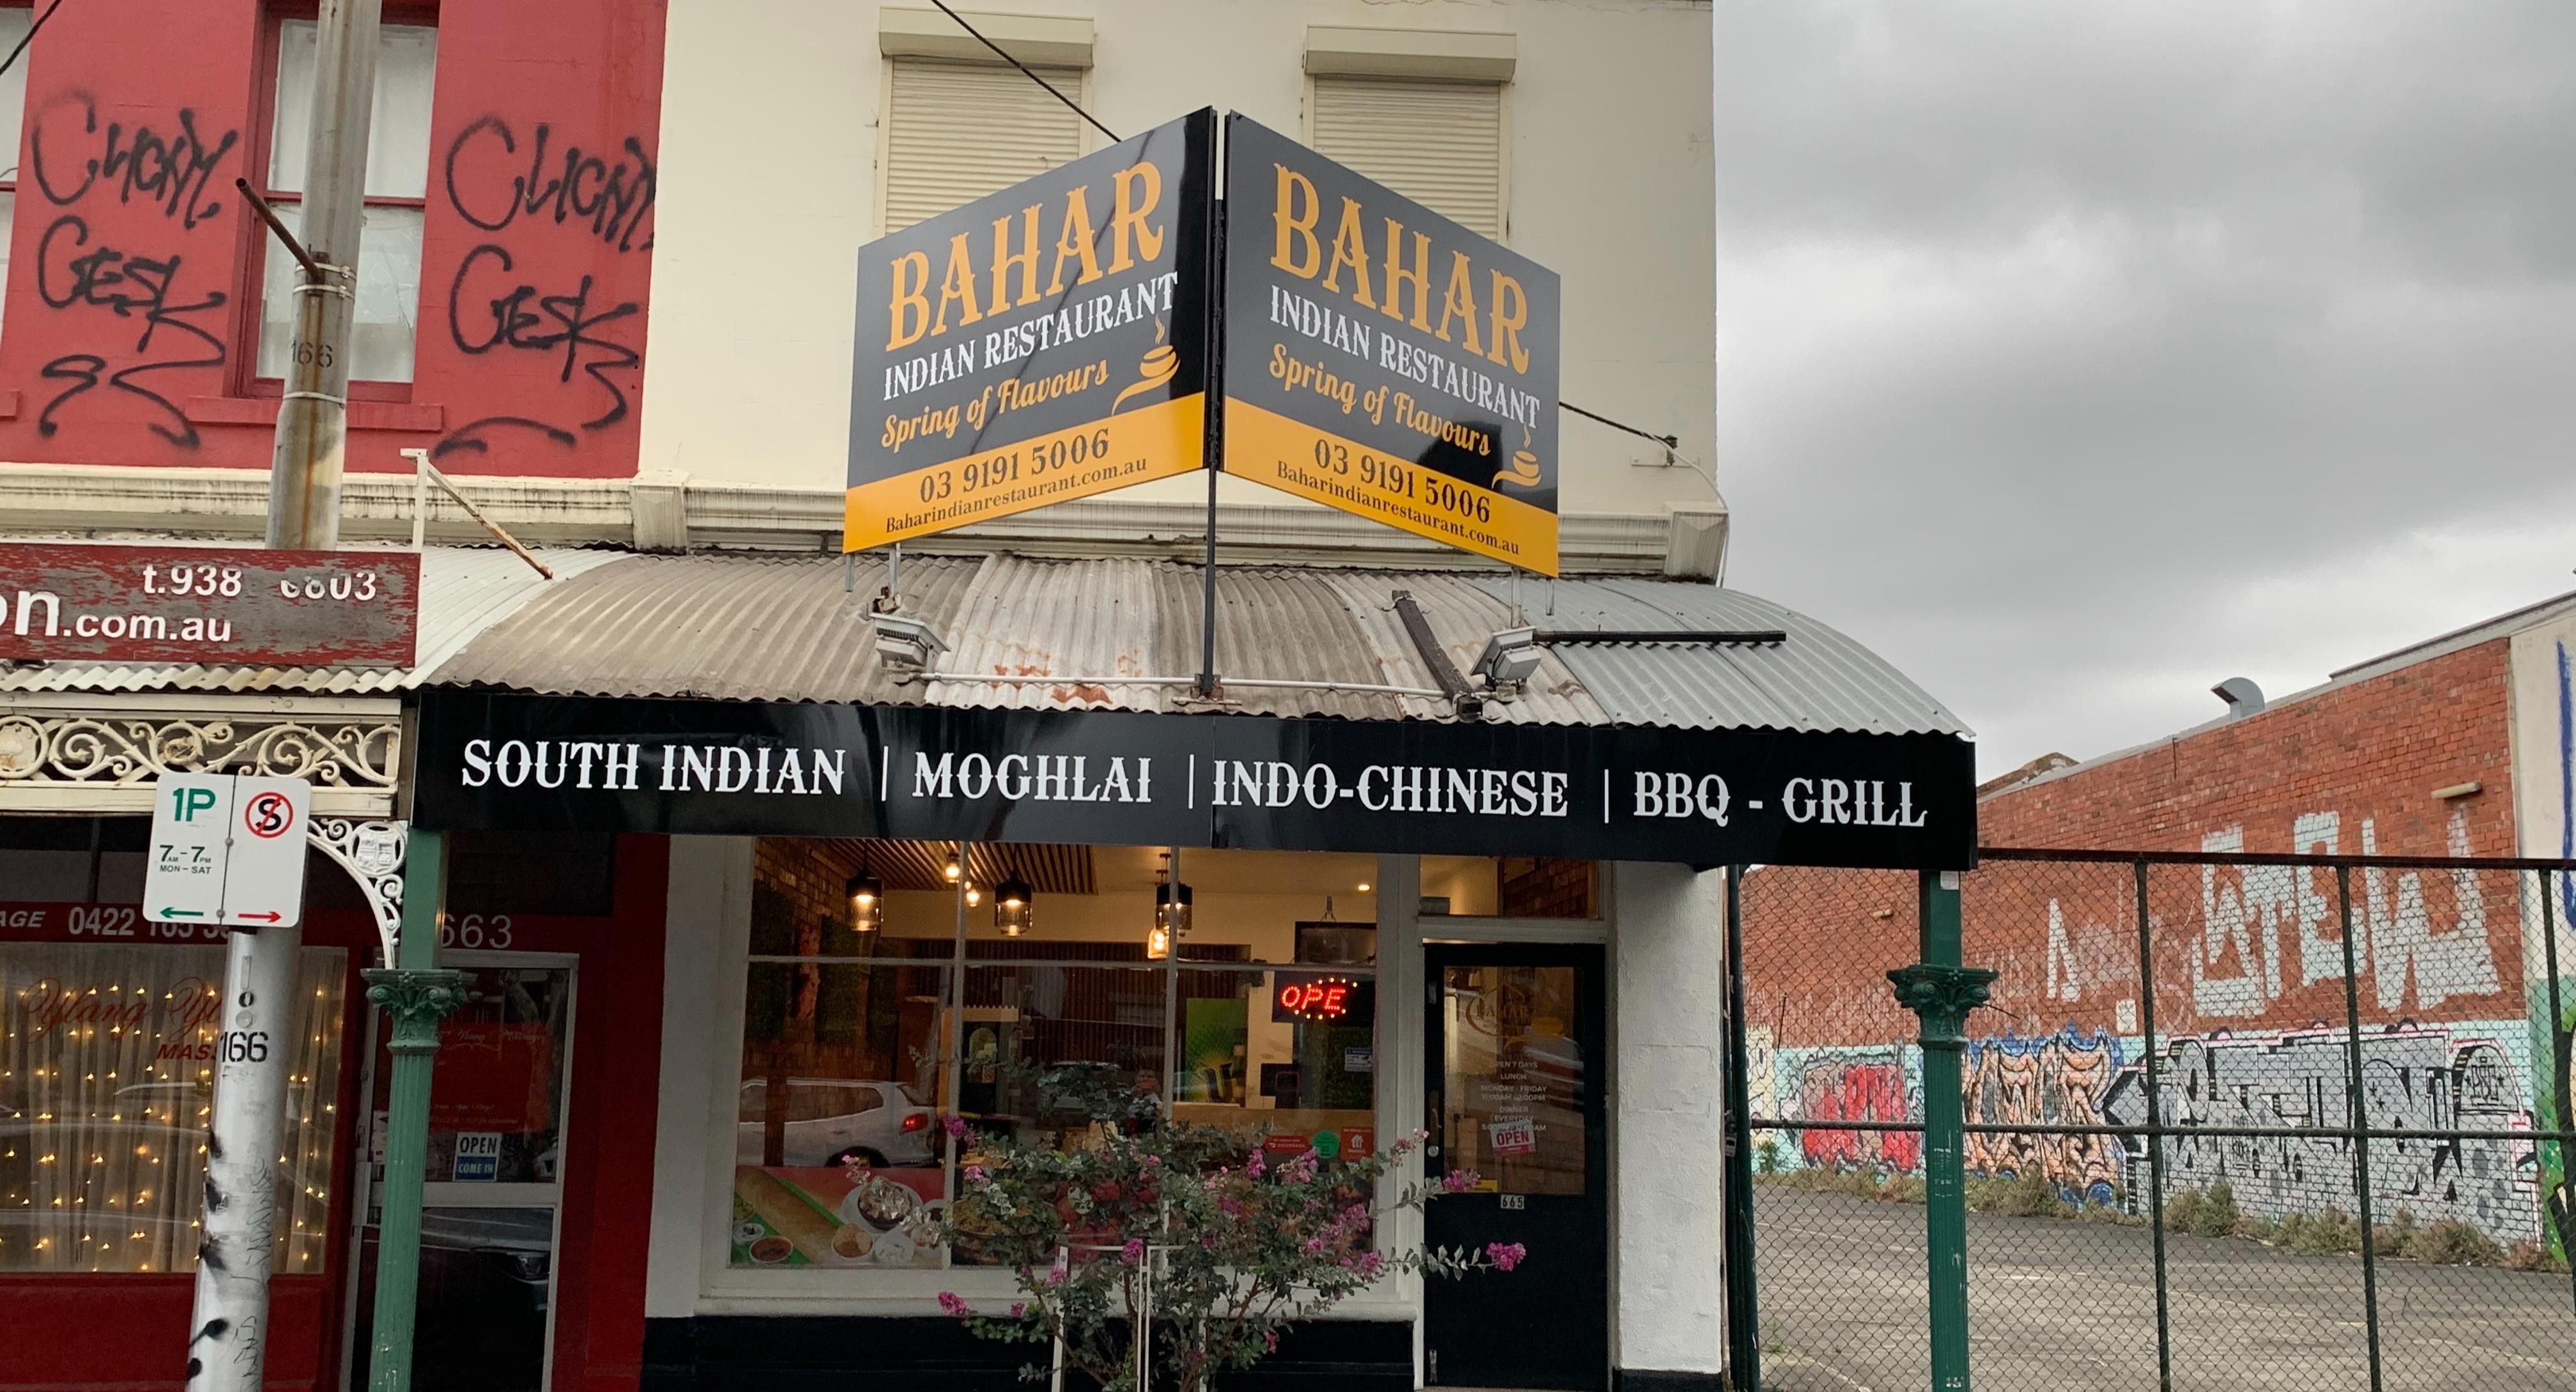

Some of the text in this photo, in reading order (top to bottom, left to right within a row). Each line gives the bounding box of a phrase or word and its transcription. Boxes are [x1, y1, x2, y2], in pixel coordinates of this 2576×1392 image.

[886, 162, 1163, 351] BAHAR
[1270, 162, 1529, 374] BAHAR
[292, 340, 332, 368] 166
[884, 272, 1177, 400] INDIAN RESTAURANT
[1270, 285, 1540, 429] INDIAN RESTAURANT
[882, 359, 1110, 454] Spring of Flavours
[1269, 343, 1491, 457] Spring of Flavours
[885, 457, 1147, 533] Baharindianrestaurant.com.au
[920, 428, 1110, 503] 03 9191 5006
[1314, 439, 1491, 523] 03 9191 5006
[1277, 460, 1520, 555] Baharindianrestaurant.com.au
[142, 564, 242, 597] t.938
[0, 590, 231, 642] n.com.au
[172, 788, 216, 822] 1P
[461, 738, 640, 791] SOUTH
[659, 744, 846, 796] INDIAN
[912, 750, 1153, 804] MOGHLAI
[1212, 759, 1569, 818] INDO-CHINESE
[1632, 770, 1729, 826] BBQ
[1781, 777, 1928, 827] GRILL
[160, 864, 180, 873] MON
[191, 866, 211, 875] SAT
[68, 906, 135, 936] 0422
[20, 977, 150, 1043] Ylang
[220, 1031, 268, 1062] 166
[458, 1165, 494, 1174] COME IN
[459, 1136, 498, 1154] OPEN
[1496, 1130, 1529, 1145] OPEN
[1502, 1196, 1523, 1208] 665
